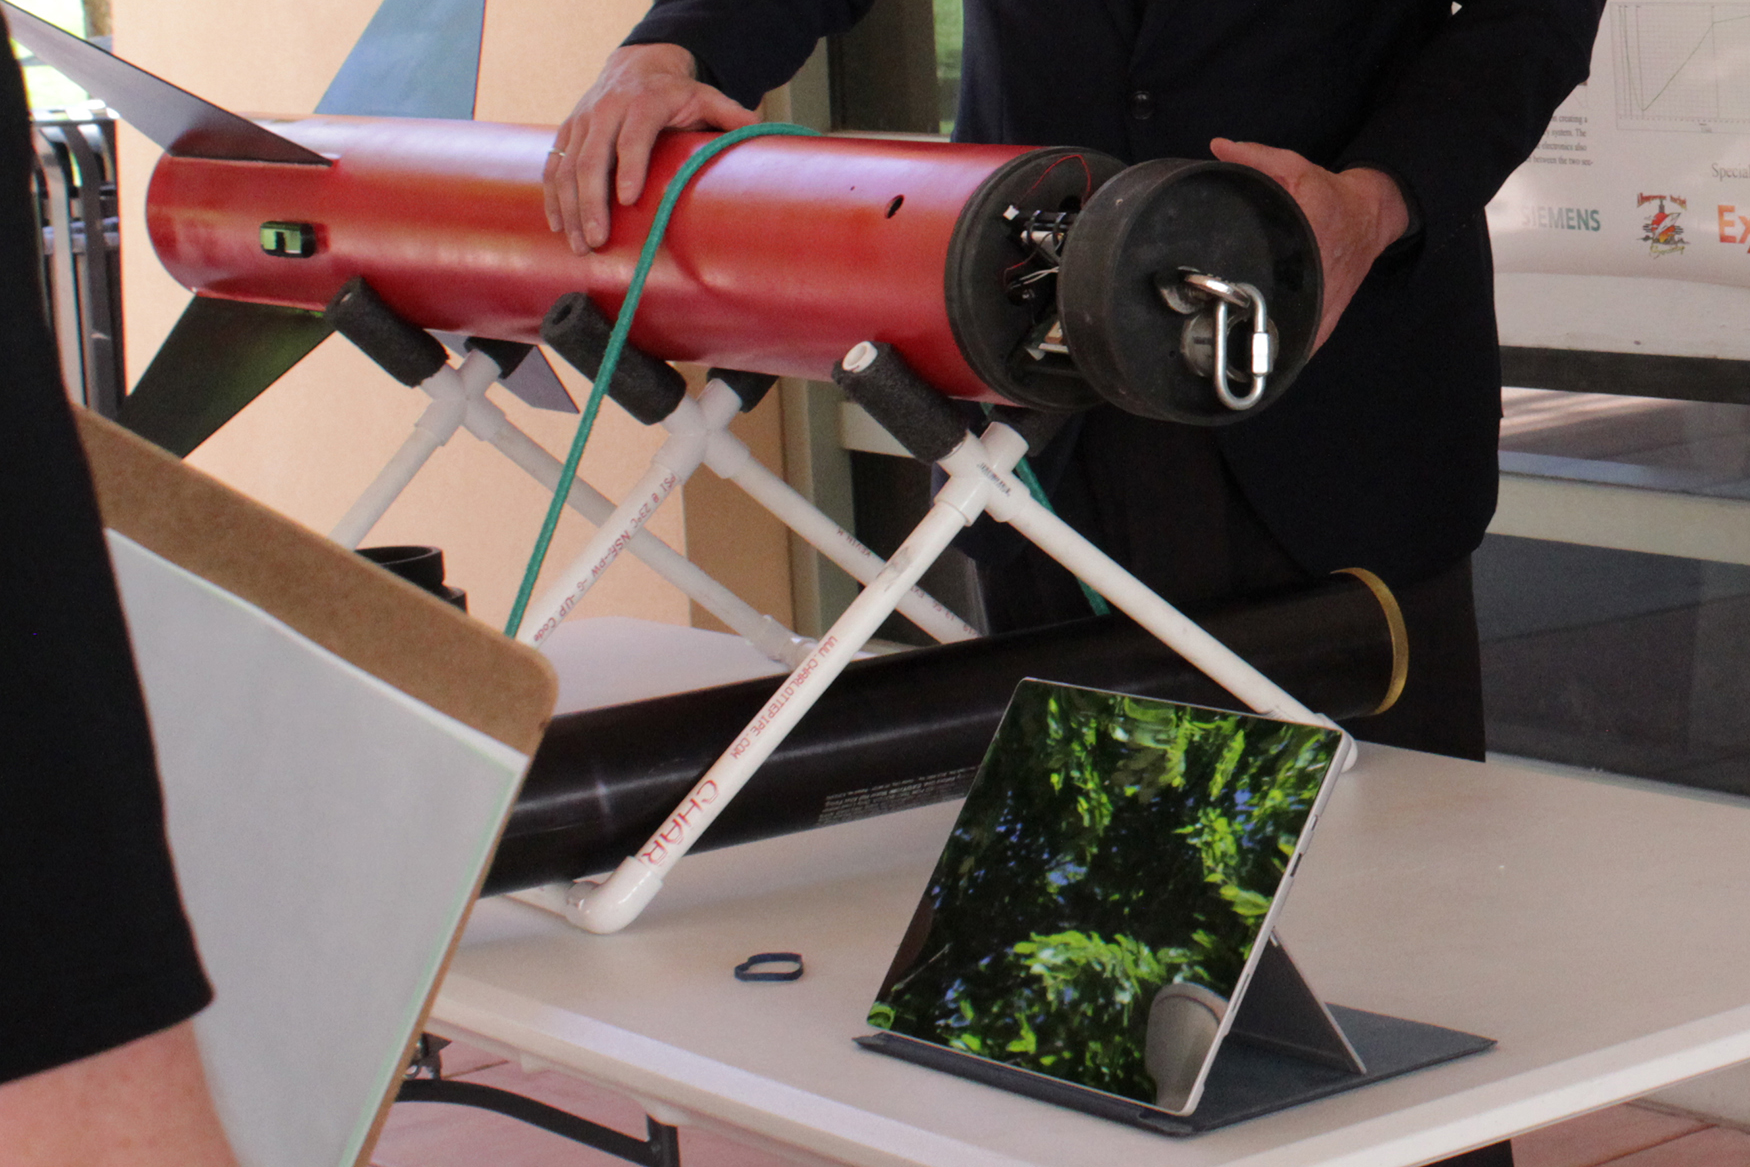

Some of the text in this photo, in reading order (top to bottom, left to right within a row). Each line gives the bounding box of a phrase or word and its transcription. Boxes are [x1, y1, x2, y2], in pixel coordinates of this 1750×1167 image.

[1521, 204, 1601, 232] SIEMENS
[660, 474, 675, 490] PSI
[533, 617, 556, 642] Code
[641, 779, 720, 869] CHAR
